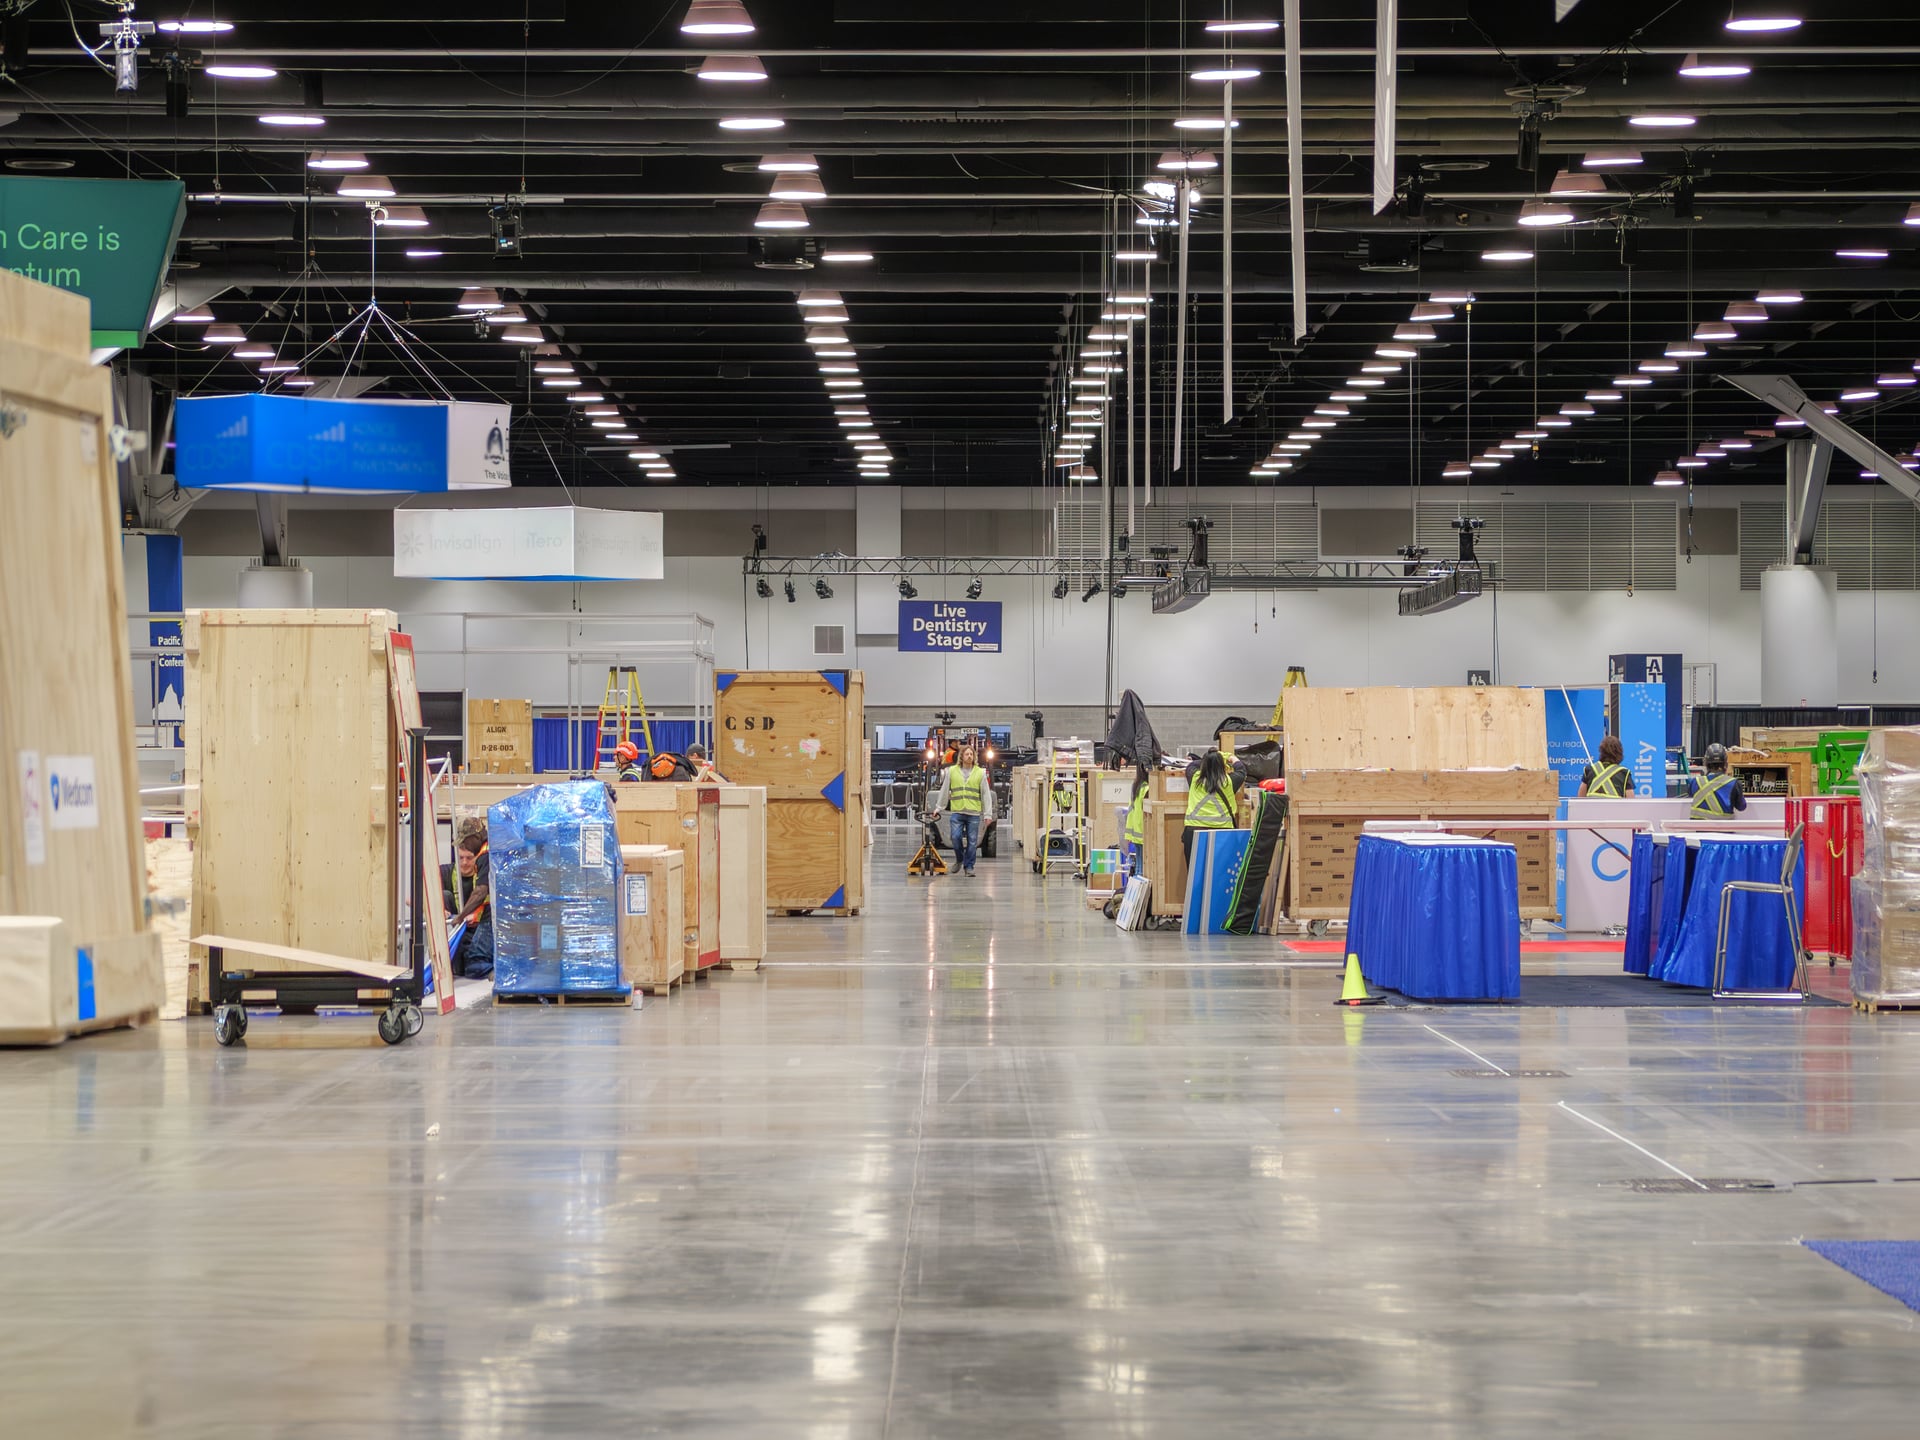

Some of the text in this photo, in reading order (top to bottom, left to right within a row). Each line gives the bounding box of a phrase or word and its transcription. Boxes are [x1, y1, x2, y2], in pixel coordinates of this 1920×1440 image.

[18, 223, 88, 250] Care
[98, 224, 120, 251] is
[9, 261, 81, 287] ntum
[934, 603, 967, 618] Live
[913, 618, 987, 636] Dentistry
[157, 635, 181, 646] Pacific
[927, 632, 972, 650] Stage
[1562, 740, 1583, 748] read
[1548, 756, 1594, 766] ture-proof
[1634, 740, 1657, 798] bility
[1558, 773, 1583, 781] actice
